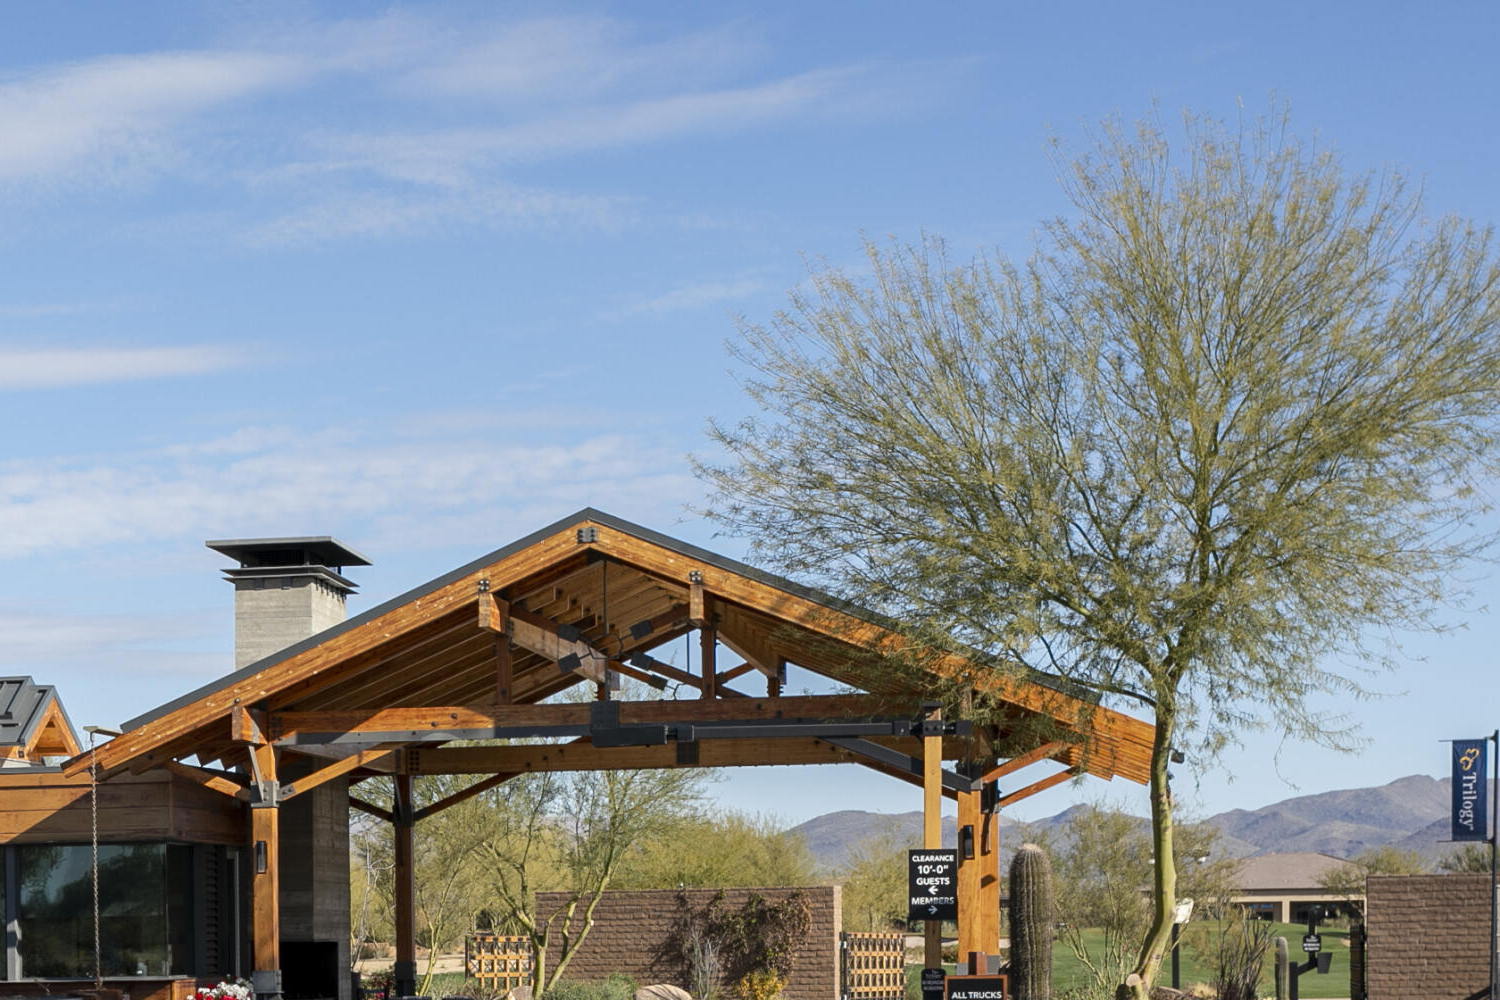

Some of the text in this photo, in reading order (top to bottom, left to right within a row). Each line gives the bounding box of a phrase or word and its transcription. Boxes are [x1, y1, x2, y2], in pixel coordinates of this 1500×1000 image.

[1459, 772, 1477, 830] Trilogy
[916, 877, 950, 885] GUESTS
[911, 897, 954, 905] MEMBERS
[951, 991, 1002, 999] ALL TRUCKS
